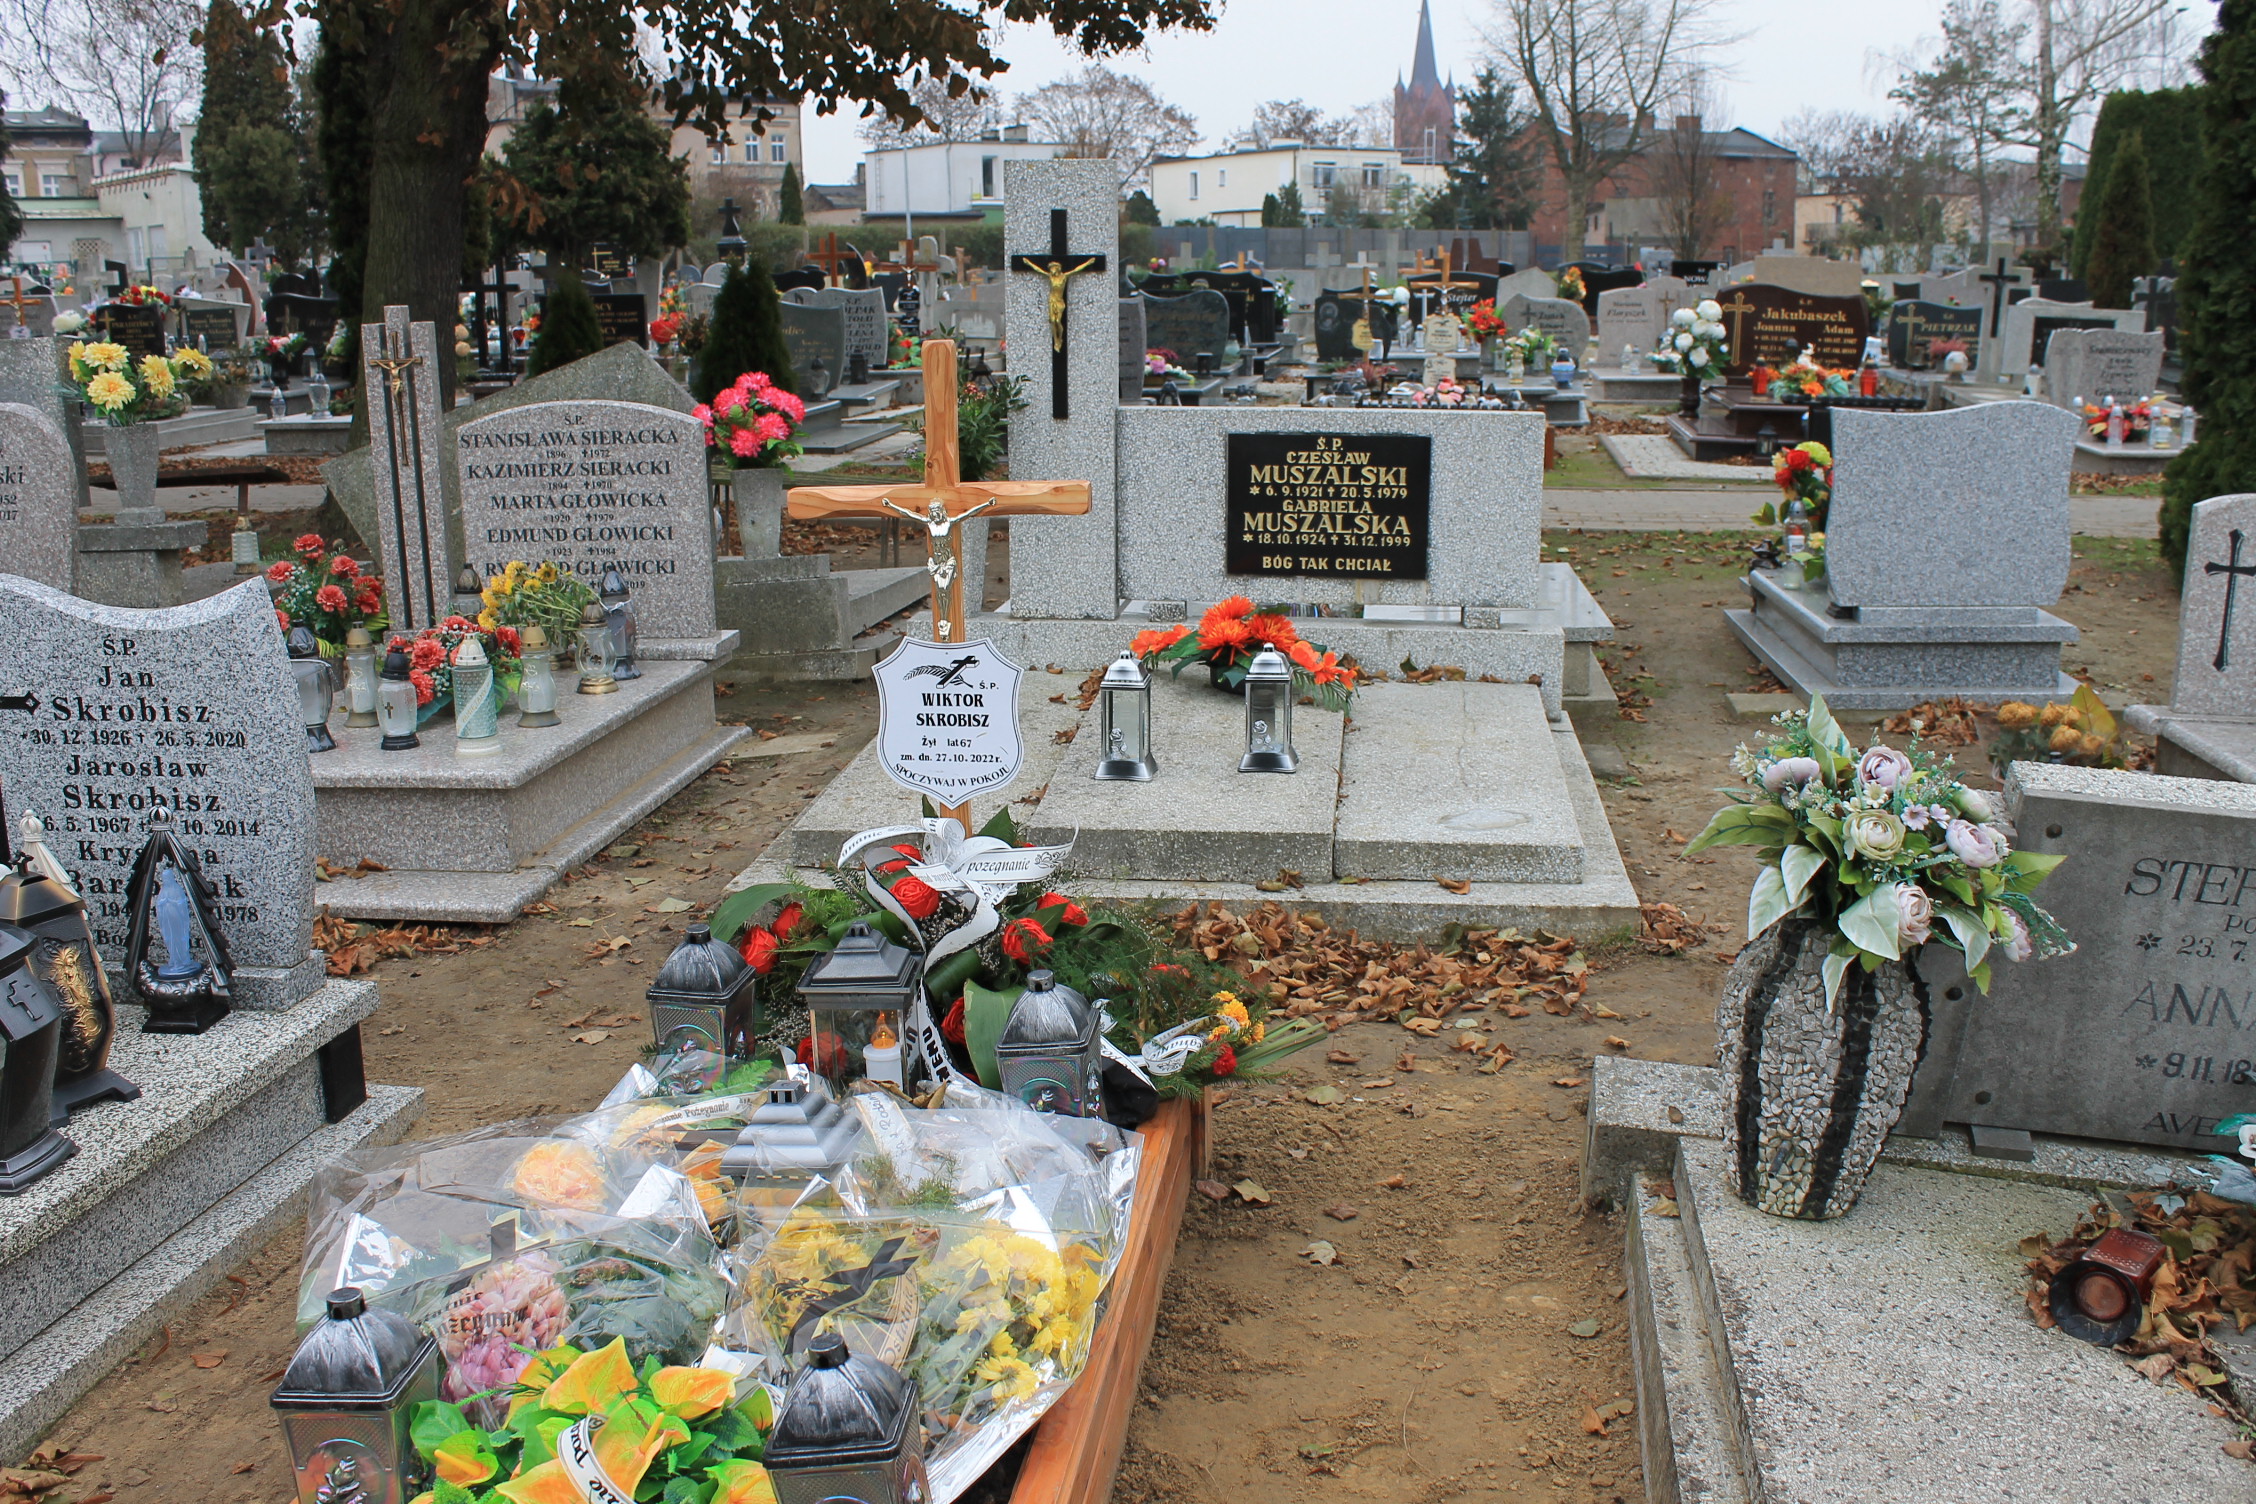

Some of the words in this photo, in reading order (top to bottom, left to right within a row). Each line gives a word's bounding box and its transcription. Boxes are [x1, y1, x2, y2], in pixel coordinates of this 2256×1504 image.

[1762, 307, 1847, 322] Jakubaszek
[1753, 321, 1797, 332] Joanna
[1823, 324, 1854, 334] Adam
[581, 429, 679, 446] SIERACKA
[1286, 451, 1371, 465] CZESŁAW
[468, 463, 576, 479] KAZIMIERZ
[580, 460, 672, 477] SIERACKI
[1250, 465, 1408, 486] MUSZALSKI
[491, 495, 557, 510] MARTA
[1282, 500, 1374, 514] GABRIELA
[1243, 512, 1411, 535] MUSZALSKA
[487, 528, 568, 543] EDMUND
[1262, 555, 1293, 569] BÓG
[1299, 557, 1329, 570] TAK
[1335, 557, 1392, 572] CHCIAŁ
[102, 634, 138, 656] Ś.P.
[99, 665, 155, 687] Jan
[921, 693, 984, 707] WIKTOR
[51, 696, 211, 722] Skrobisz
[916, 713, 990, 728] SKROBISZ
[921, 735, 937, 748] Żył
[900, 754, 915, 762] zm.
[918, 752, 933, 762] dn.
[66, 754, 208, 778] Jarosław
[894, 763, 956, 787] SPOCZYWAJ
[958, 778, 968, 787] W
[970, 764, 1011, 786] POKOJU
[62, 784, 221, 812] Skrobisz
[2142, 1111, 2222, 1139] AVE
